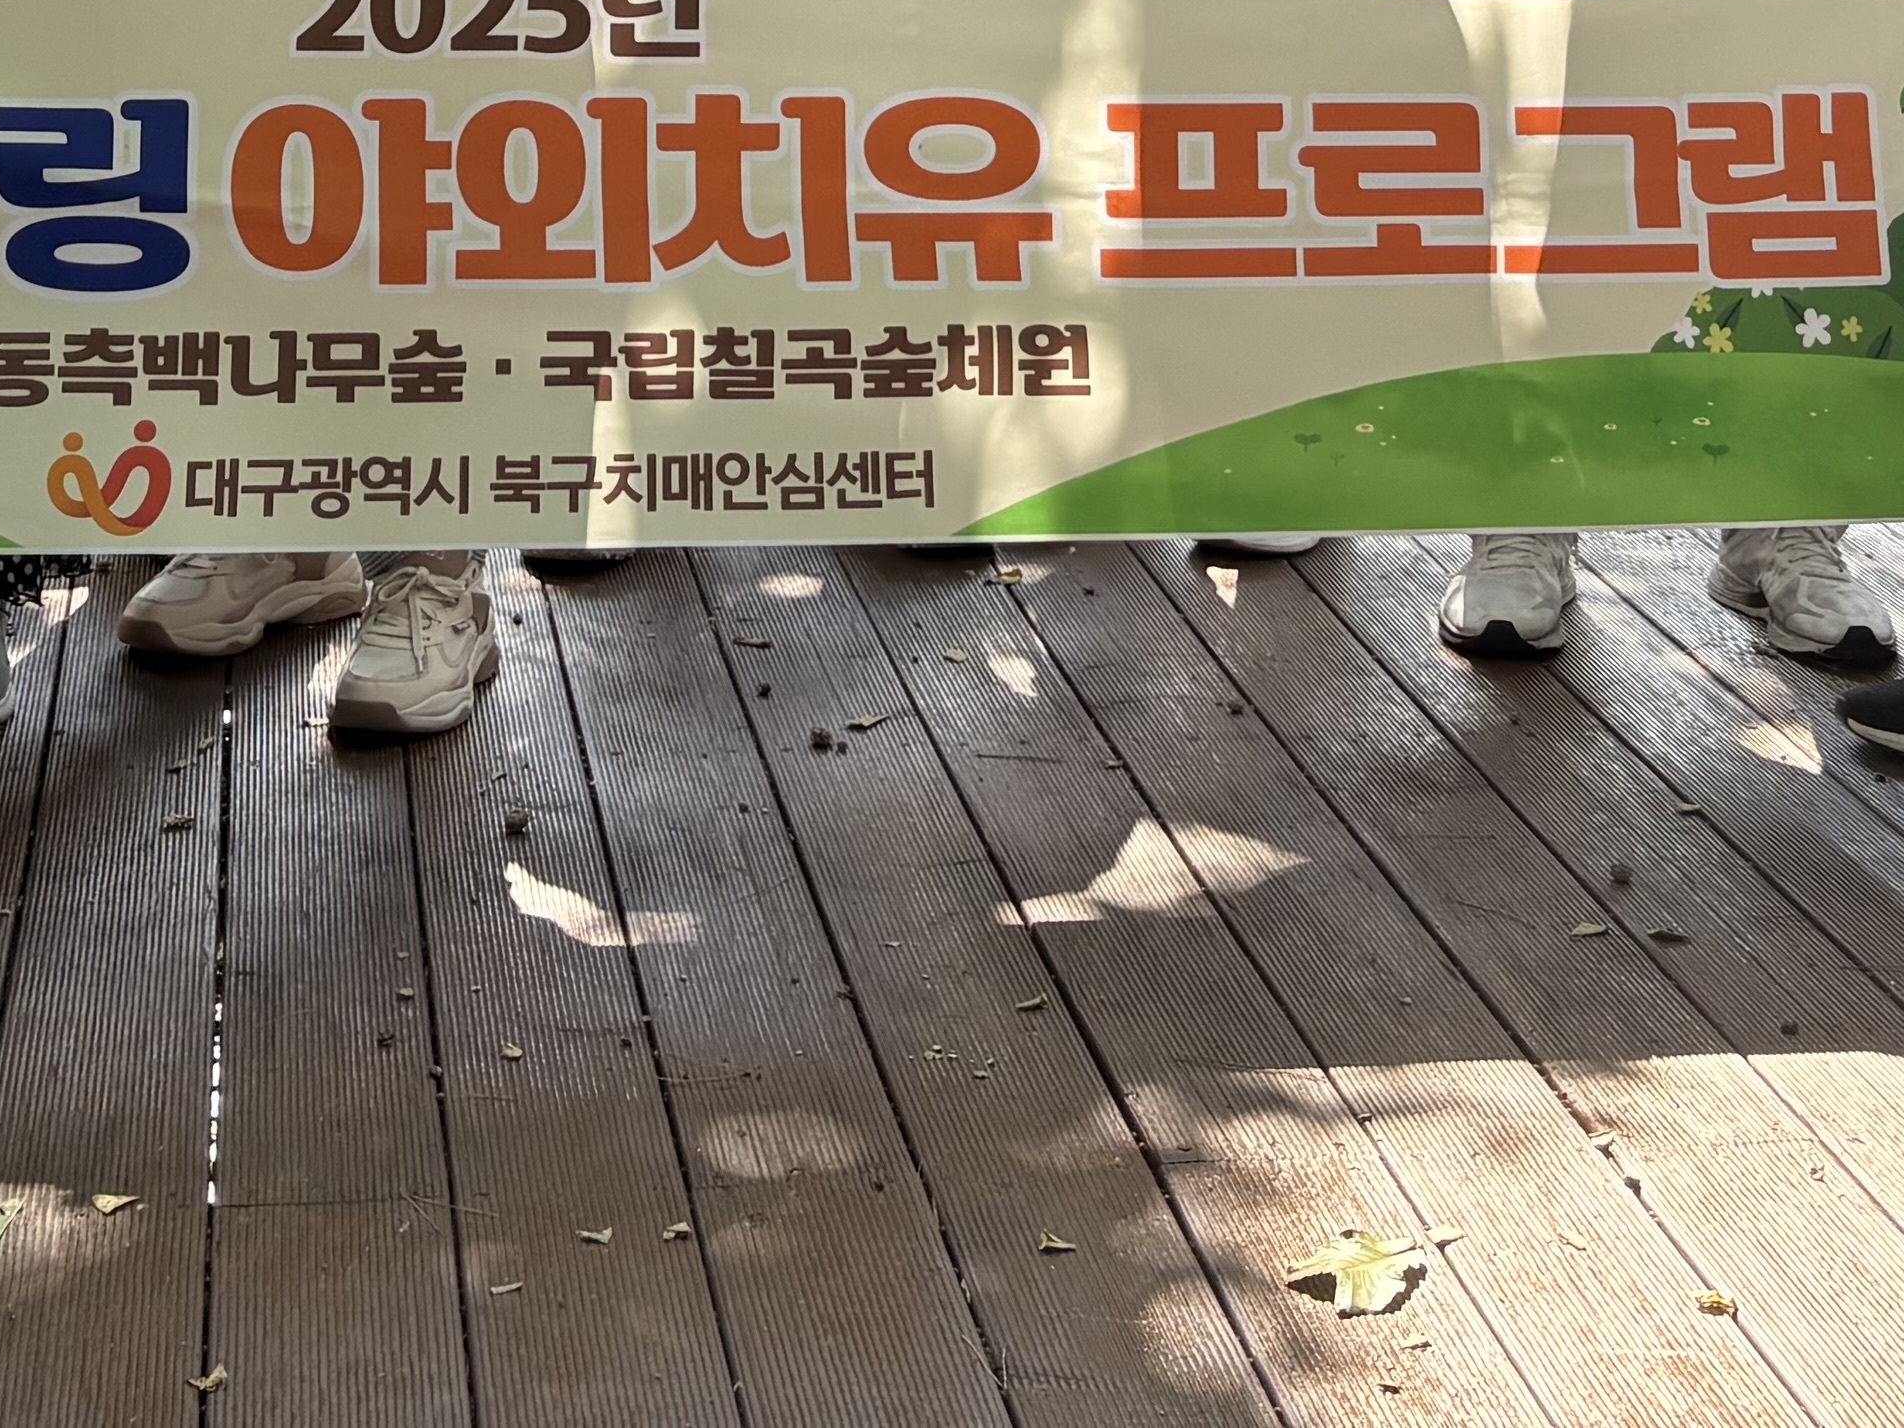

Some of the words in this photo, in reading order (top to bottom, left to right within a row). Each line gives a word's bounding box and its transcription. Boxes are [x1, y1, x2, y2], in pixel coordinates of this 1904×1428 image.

[229, 92, 1053, 285] 야외치유
[1100, 92, 1884, 282] 프로그램
[538, 323, 1092, 402] 국립칠곡숲체원
[184, 455, 471, 518] 대구광역시
[489, 449, 936, 515] 북구치매안심센터
